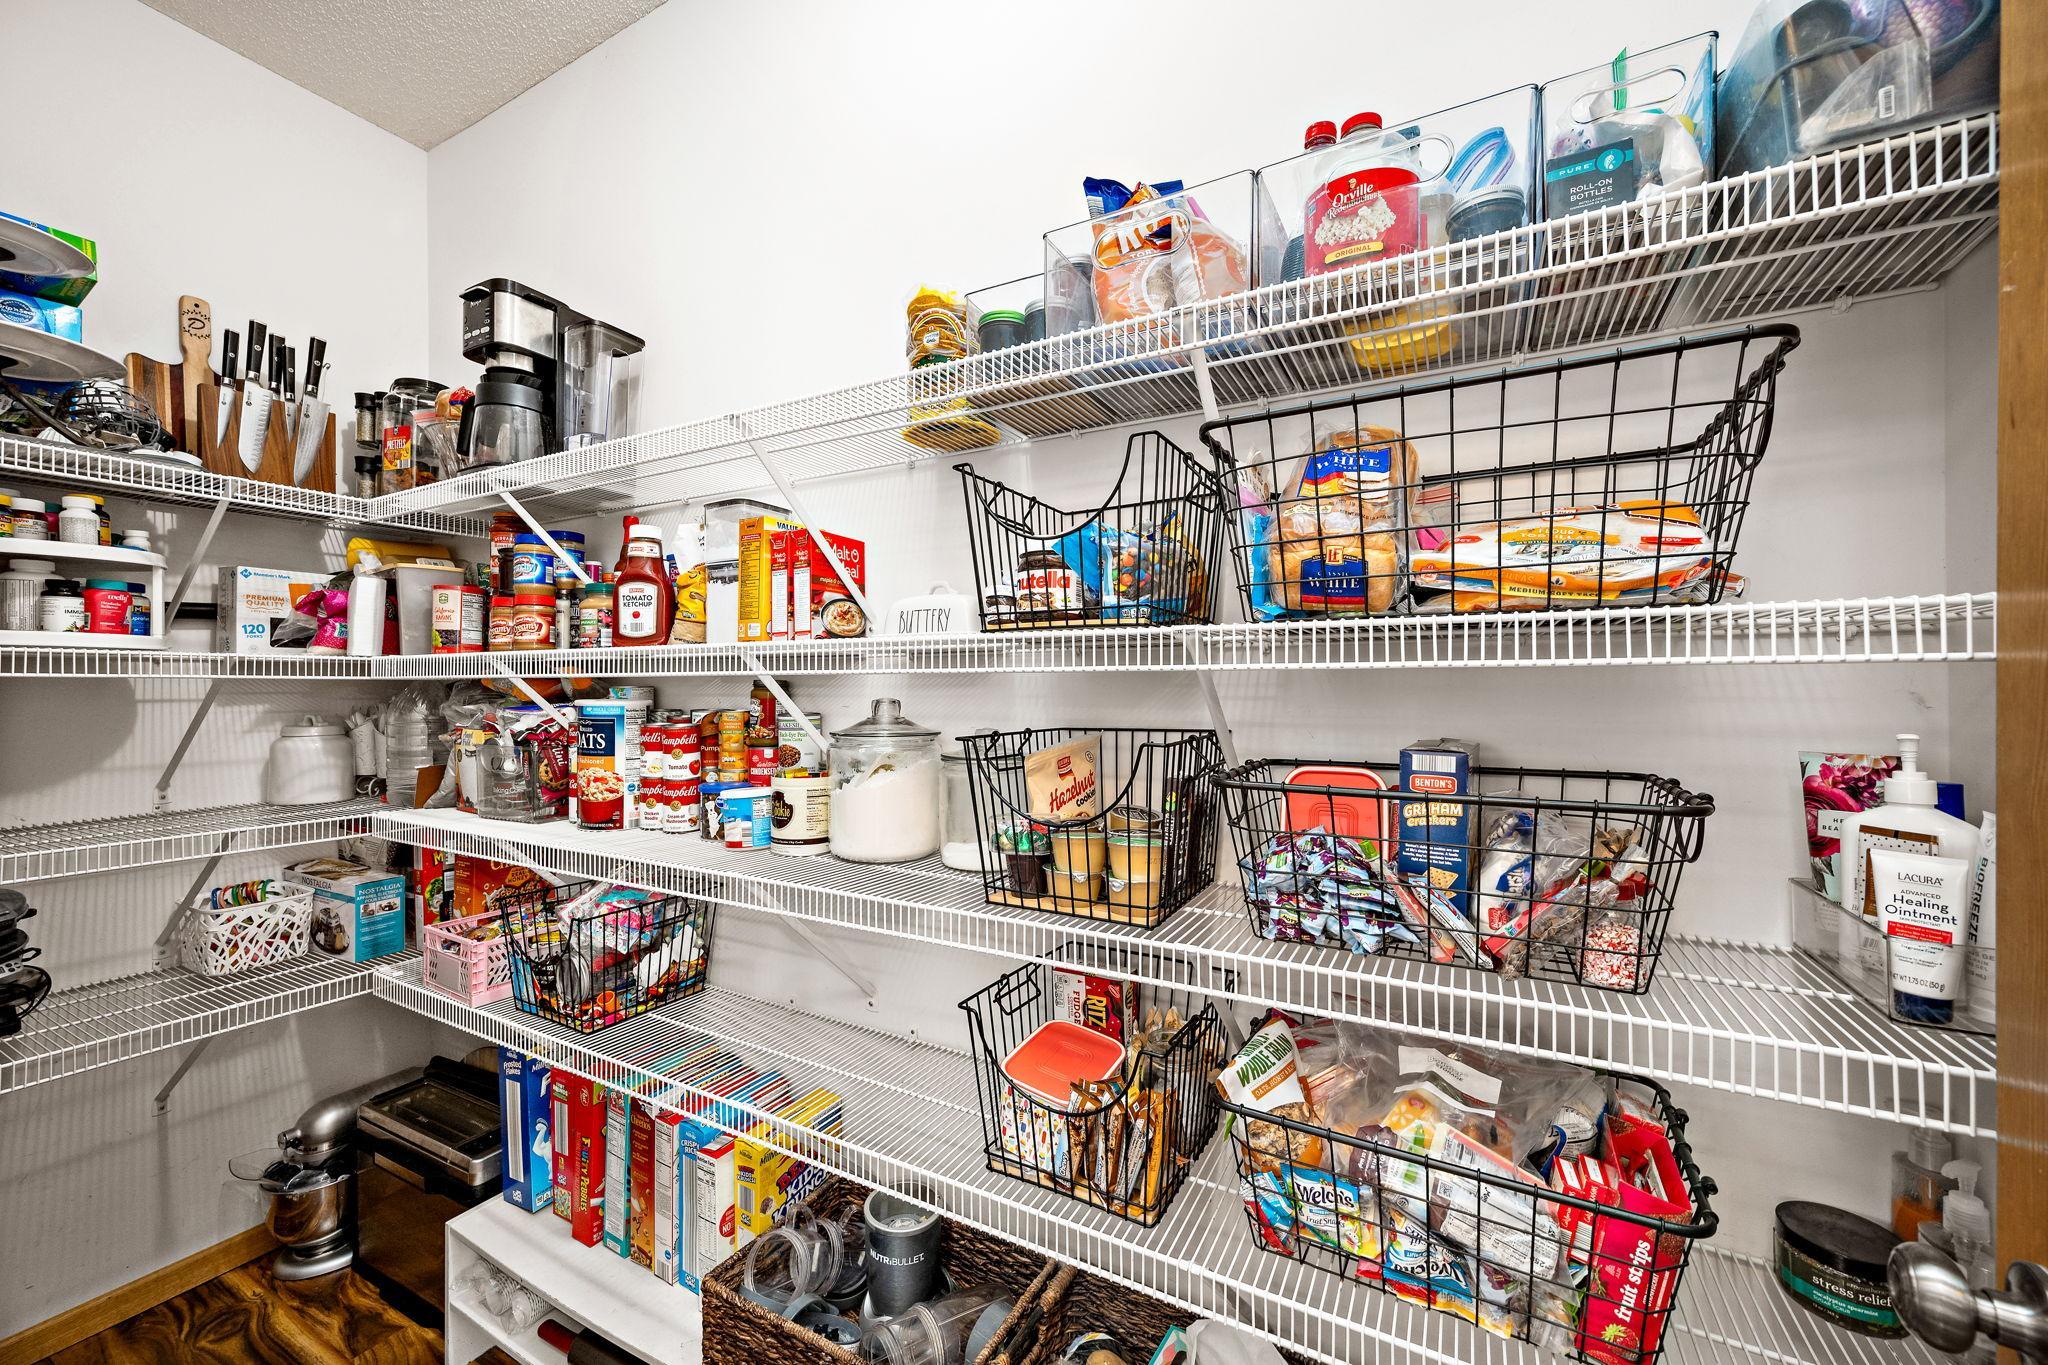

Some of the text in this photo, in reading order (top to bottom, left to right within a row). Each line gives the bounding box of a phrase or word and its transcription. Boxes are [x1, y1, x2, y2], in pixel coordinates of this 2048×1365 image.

[1559, 164, 1591, 176] PURE
[1570, 178, 1613, 194] ROLL-ON
[1332, 183, 1374, 208] Orville
[1570, 186, 1613, 202] BOTTLES
[1335, 244, 1372, 258] ORIGINAL
[386, 438, 406, 449] PRETZELS
[253, 571, 278, 579] Member's
[1018, 570, 1071, 590] nutella
[246, 594, 285, 602] PREMIUM
[246, 600, 285, 608] QUALITY
[622, 594, 653, 602] TOMATO
[241, 623, 266, 635] 120
[661, 733, 698, 748] Campbell's
[700, 745, 719, 753] Pump
[1415, 777, 1453, 789] BENTON'S
[662, 785, 697, 798] Campbell's
[1049, 769, 1094, 813] Hazelnut
[508, 874, 530, 883] HONEY
[511, 870, 526, 878] REAL
[302, 876, 332, 890] NOSTALGIA
[359, 883, 401, 895] NOSTALGIA
[1900, 889, 1941, 900] ADVANCED
[1966, 856, 1988, 945] BIOFREEZE
[1893, 893, 1949, 914] Healing
[1885, 904, 1958, 926] Ointment
[1908, 976, 1919, 985] 1.75
[1919, 978, 1928, 987] OZ
[1087, 994, 1108, 1029] RITZ
[503, 1060, 522, 1070] Frosted
[1236, 1032, 1294, 1088] WHOLE GRAIN
[505, 1067, 521, 1076] Flakes
[630, 1113, 652, 1131] Cheerios
[1812, 1275, 1893, 1307] stress relief
[1613, 1283, 1639, 1323] fruit
[1812, 1289, 1879, 1317] eucalyptus spearmint
